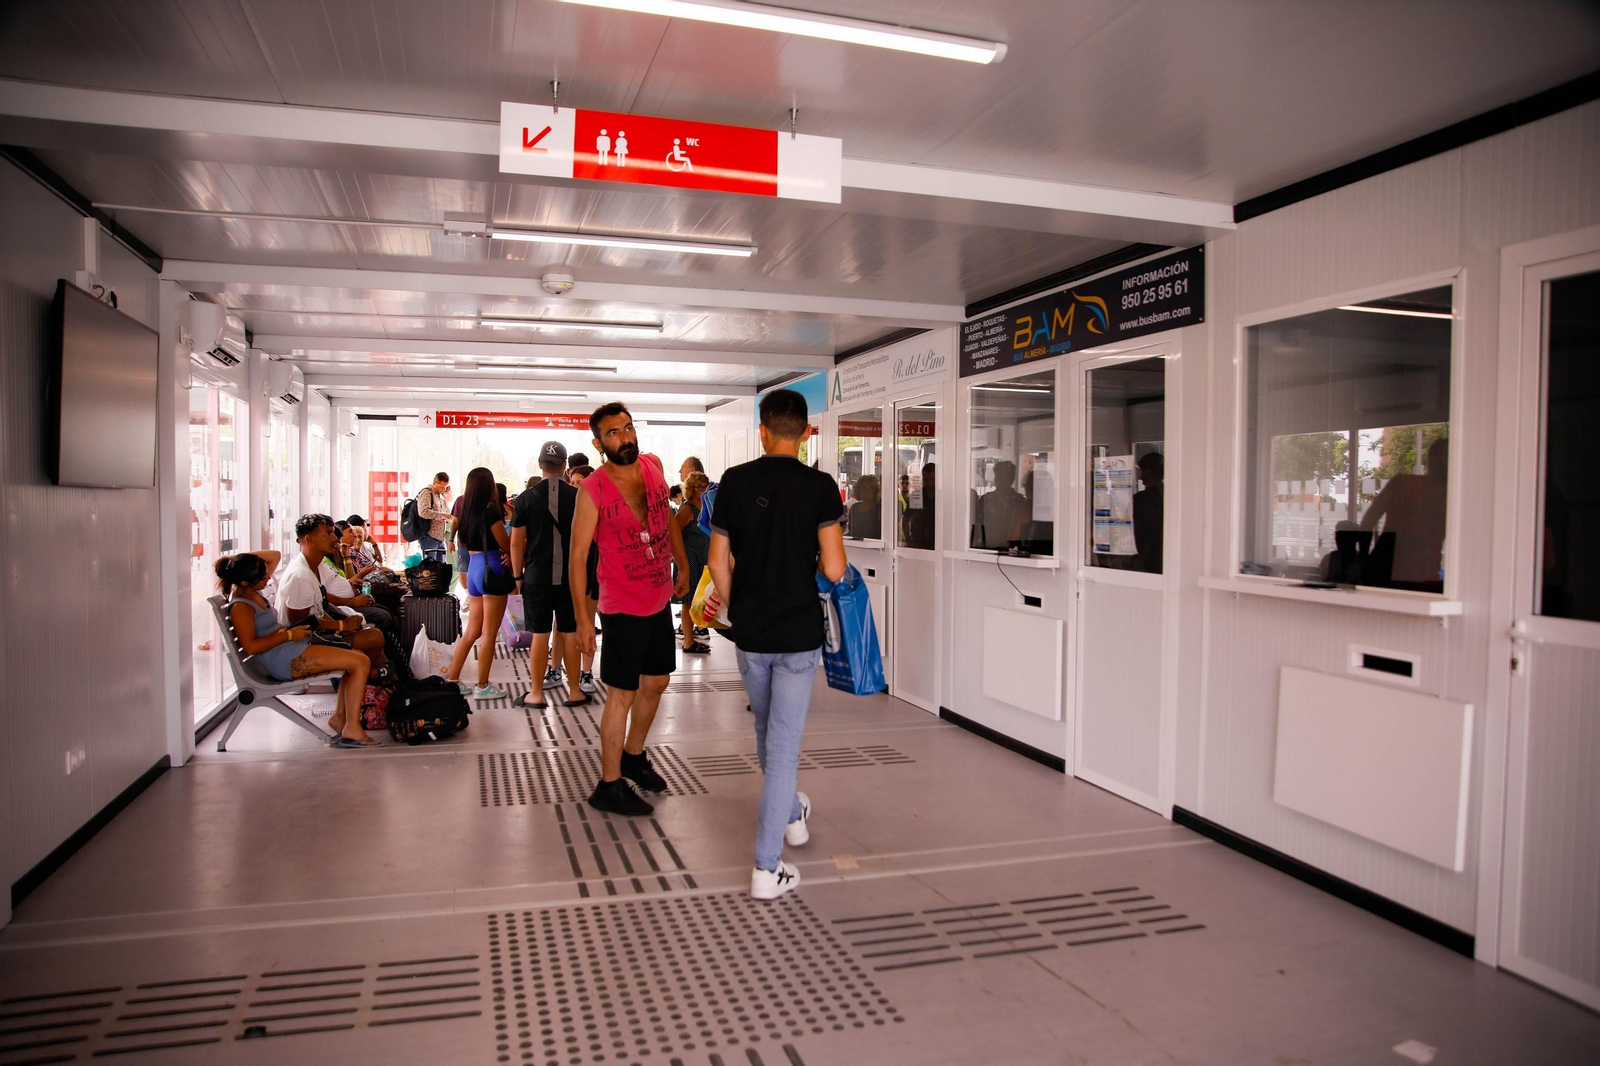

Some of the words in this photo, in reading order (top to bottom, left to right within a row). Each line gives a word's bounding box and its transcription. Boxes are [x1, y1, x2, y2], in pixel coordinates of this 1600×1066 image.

[685, 137, 700, 147] WC
[1122, 261, 1189, 290] INFORMACIÓN
[1121, 292, 1140, 309] 950
[1143, 287, 1156, 304] 25
[1158, 282, 1172, 300] 95
[1174, 278, 1188, 295] 61
[1013, 302, 1076, 350] BAM
[1119, 306, 1191, 330] www.busbam.com
[905, 353, 921, 377] del
[920, 349, 945, 372] Pino
[1013, 352, 1024, 362] BUS
[1050, 341, 1071, 353] MADRID
[443, 414, 457, 425] D1
[466, 415, 479, 426] 23
